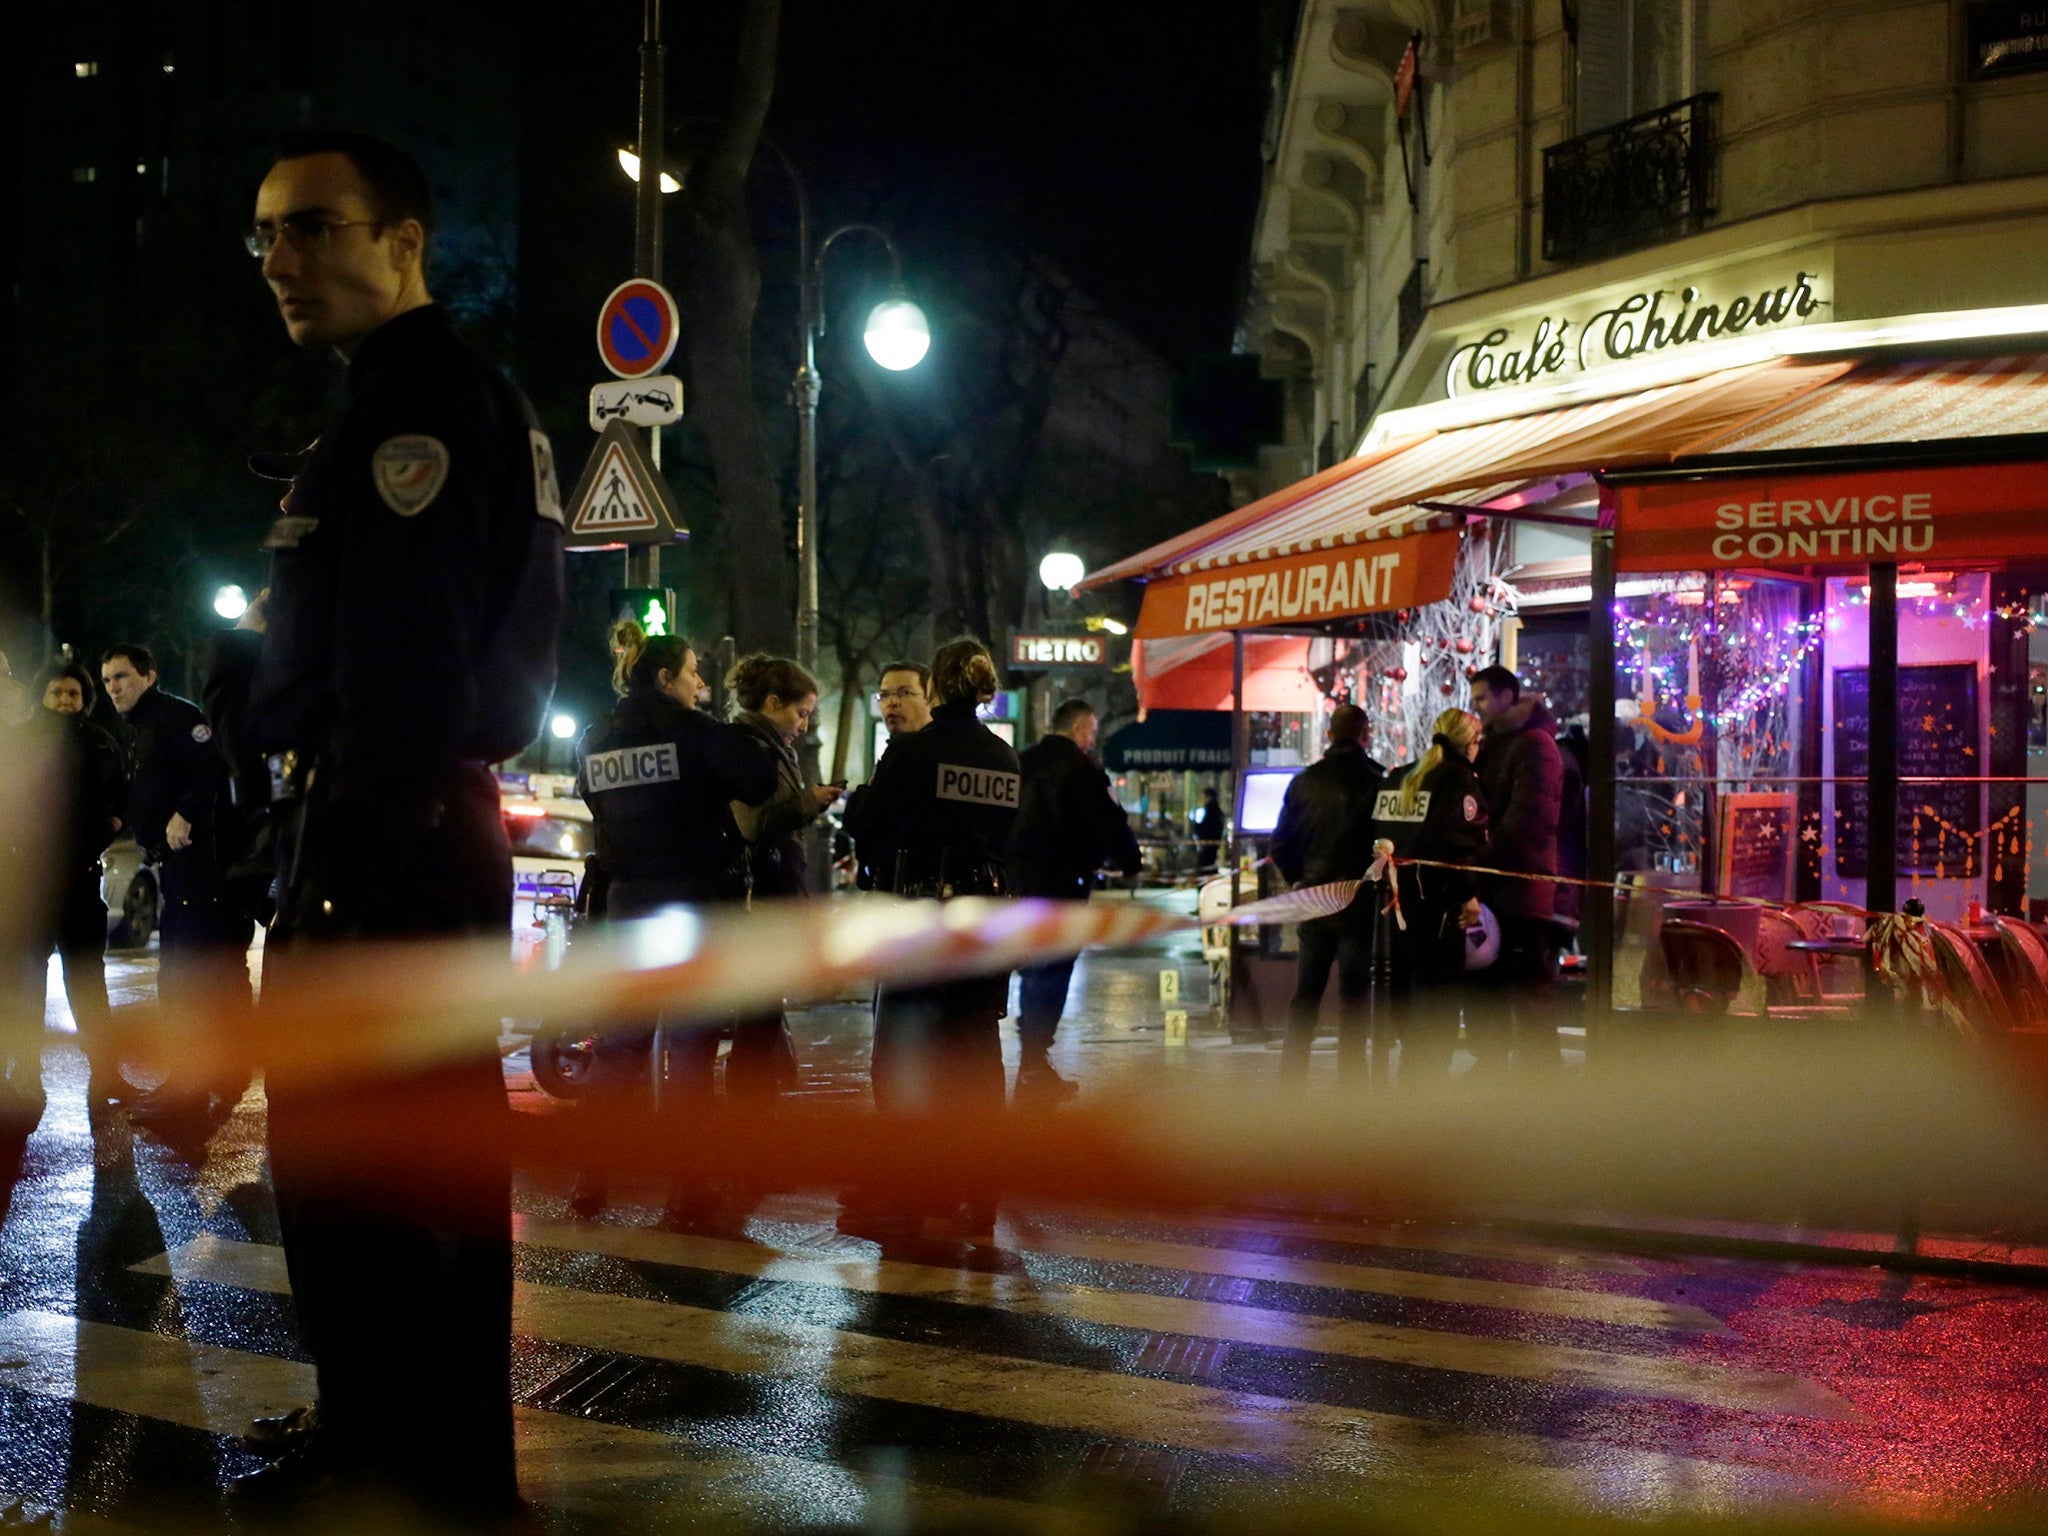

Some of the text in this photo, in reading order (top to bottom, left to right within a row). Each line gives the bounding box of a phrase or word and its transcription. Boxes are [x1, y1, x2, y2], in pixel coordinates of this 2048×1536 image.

[1446, 271, 1819, 398] Café Chineur
[1715, 493, 1933, 530] SERVICE
[1711, 524, 1934, 560] CONTINU
[1184, 552, 1400, 631] RESTAURANT
[589, 749, 673, 787] POLICE
[1122, 748, 1185, 765] PRODUIT
[943, 770, 1016, 802] POLICE
[1165, 974, 1174, 993] 2
